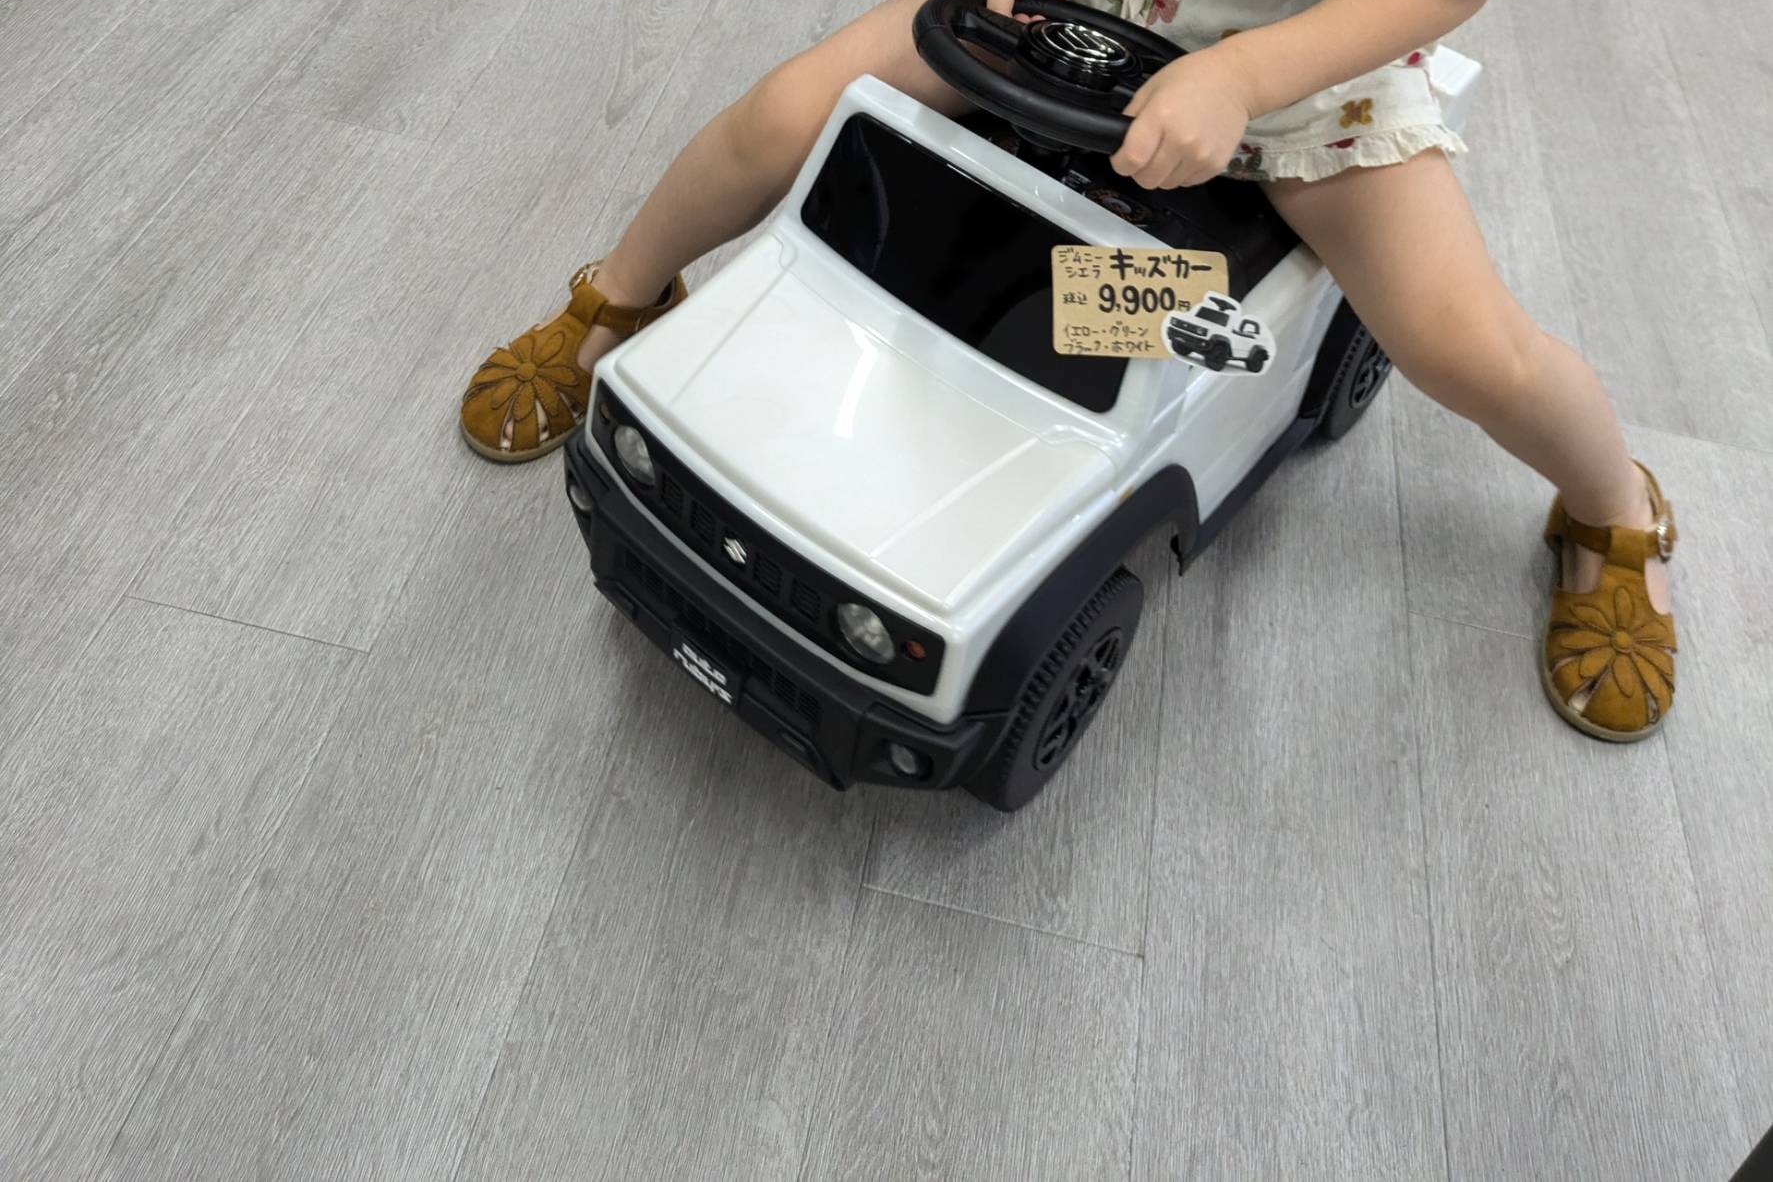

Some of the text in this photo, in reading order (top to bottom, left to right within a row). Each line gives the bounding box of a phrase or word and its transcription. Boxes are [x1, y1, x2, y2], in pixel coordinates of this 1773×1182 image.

[1058, 247, 1103, 264] ジムニー
[1065, 265, 1102, 278] シエラ
[1109, 248, 1213, 281] キッズカー
[1063, 292, 1088, 305] 税込
